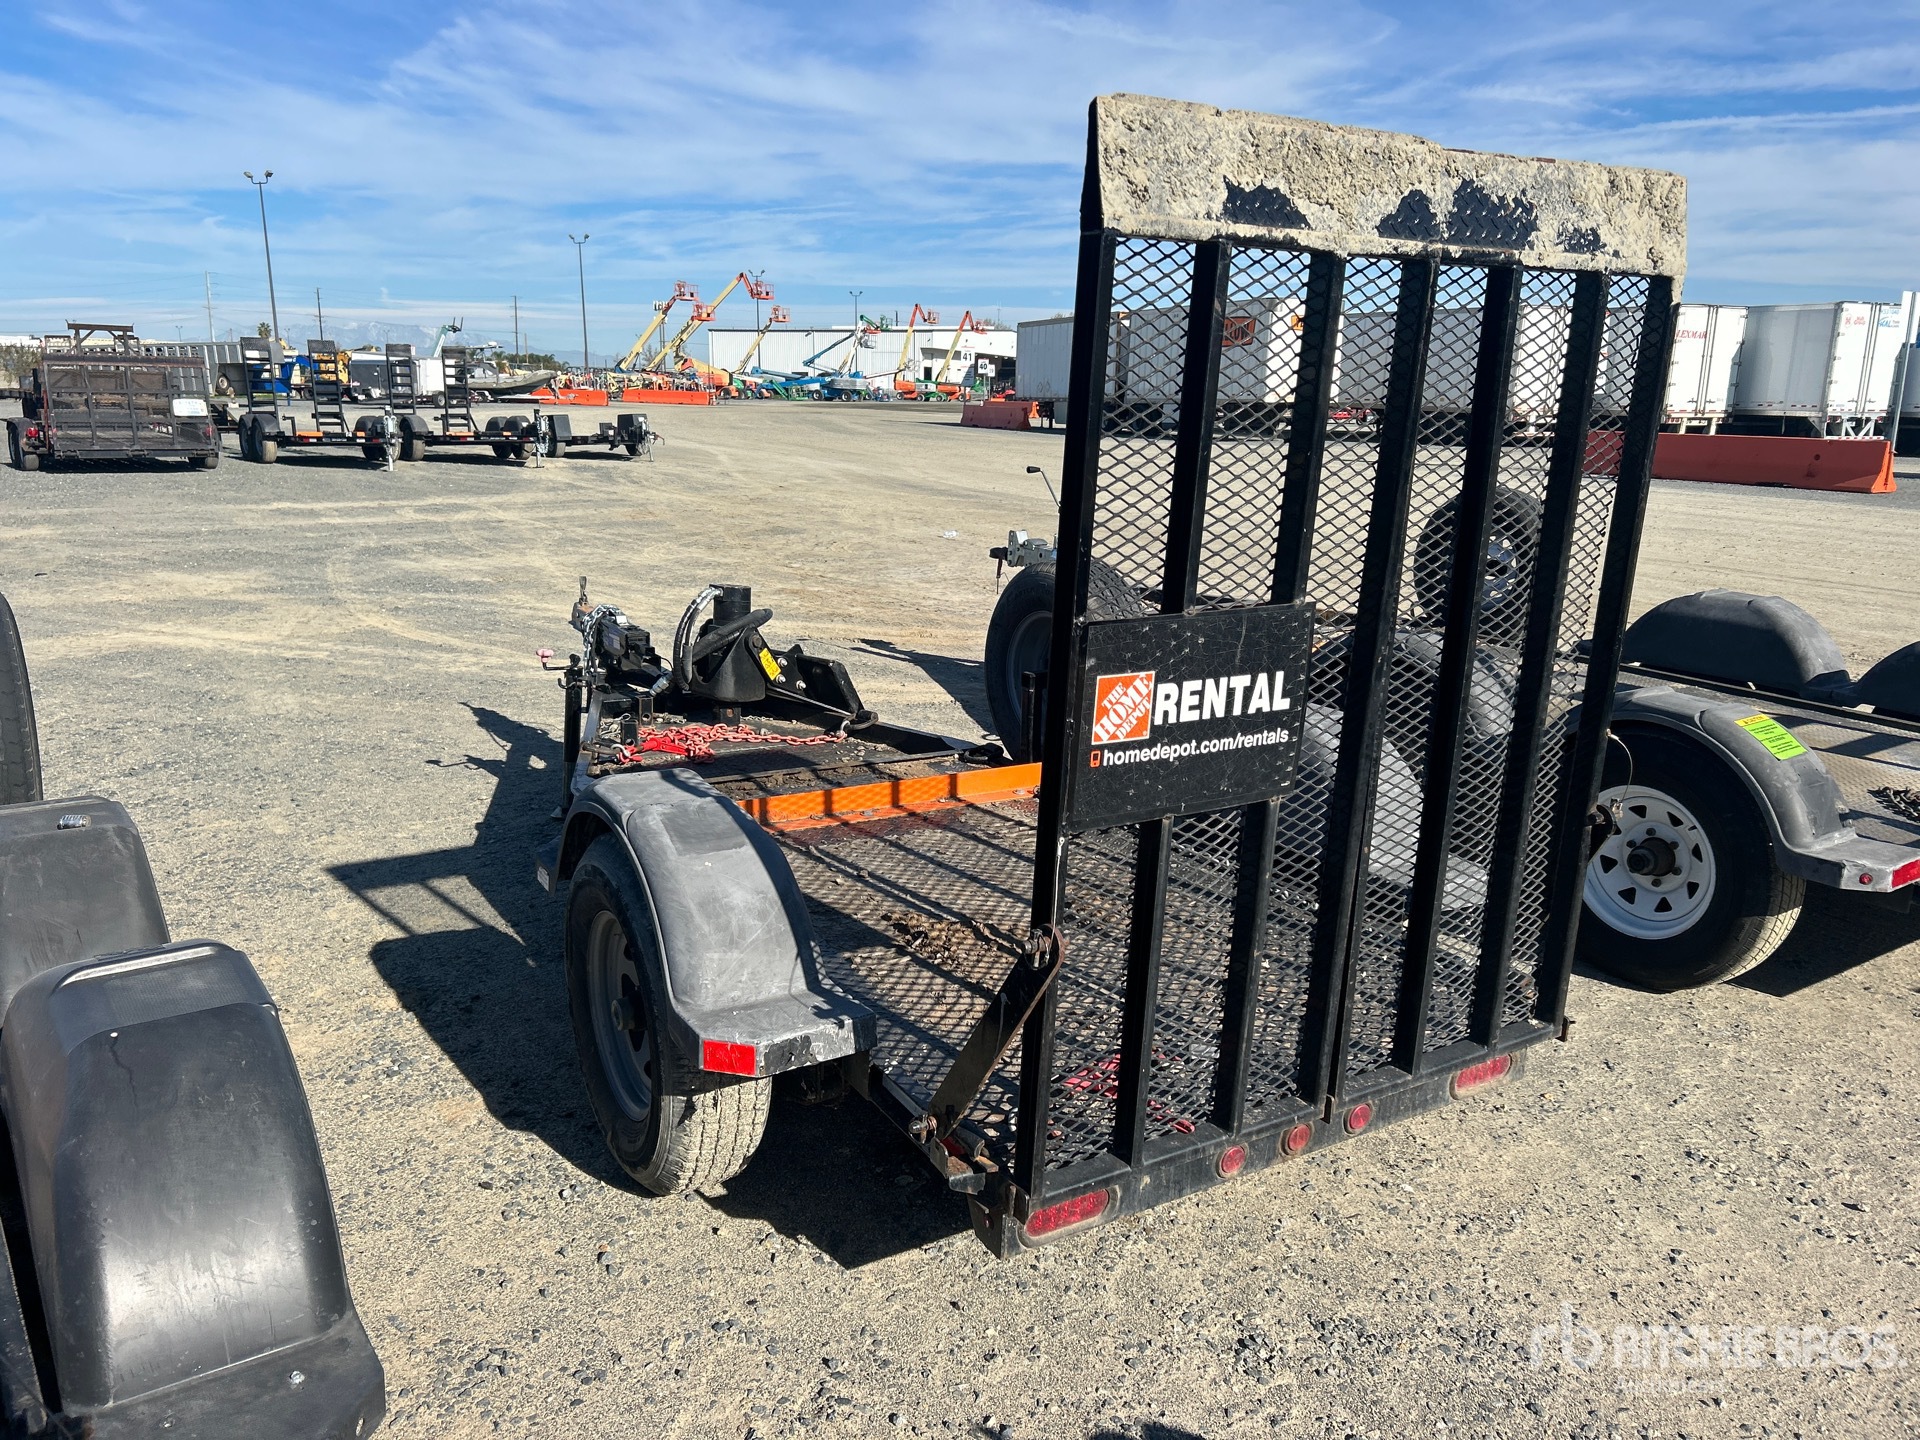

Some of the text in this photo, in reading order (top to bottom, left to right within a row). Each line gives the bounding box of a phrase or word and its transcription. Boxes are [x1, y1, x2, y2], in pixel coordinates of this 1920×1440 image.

[963, 353, 972, 361] 41
[1095, 672, 1152, 742] HOME
[1101, 682, 1127, 710] THE
[1153, 671, 1290, 726] RENTAL
[1115, 697, 1150, 740] DEPOT
[1103, 727, 1290, 766] homedepot.com/rentals
